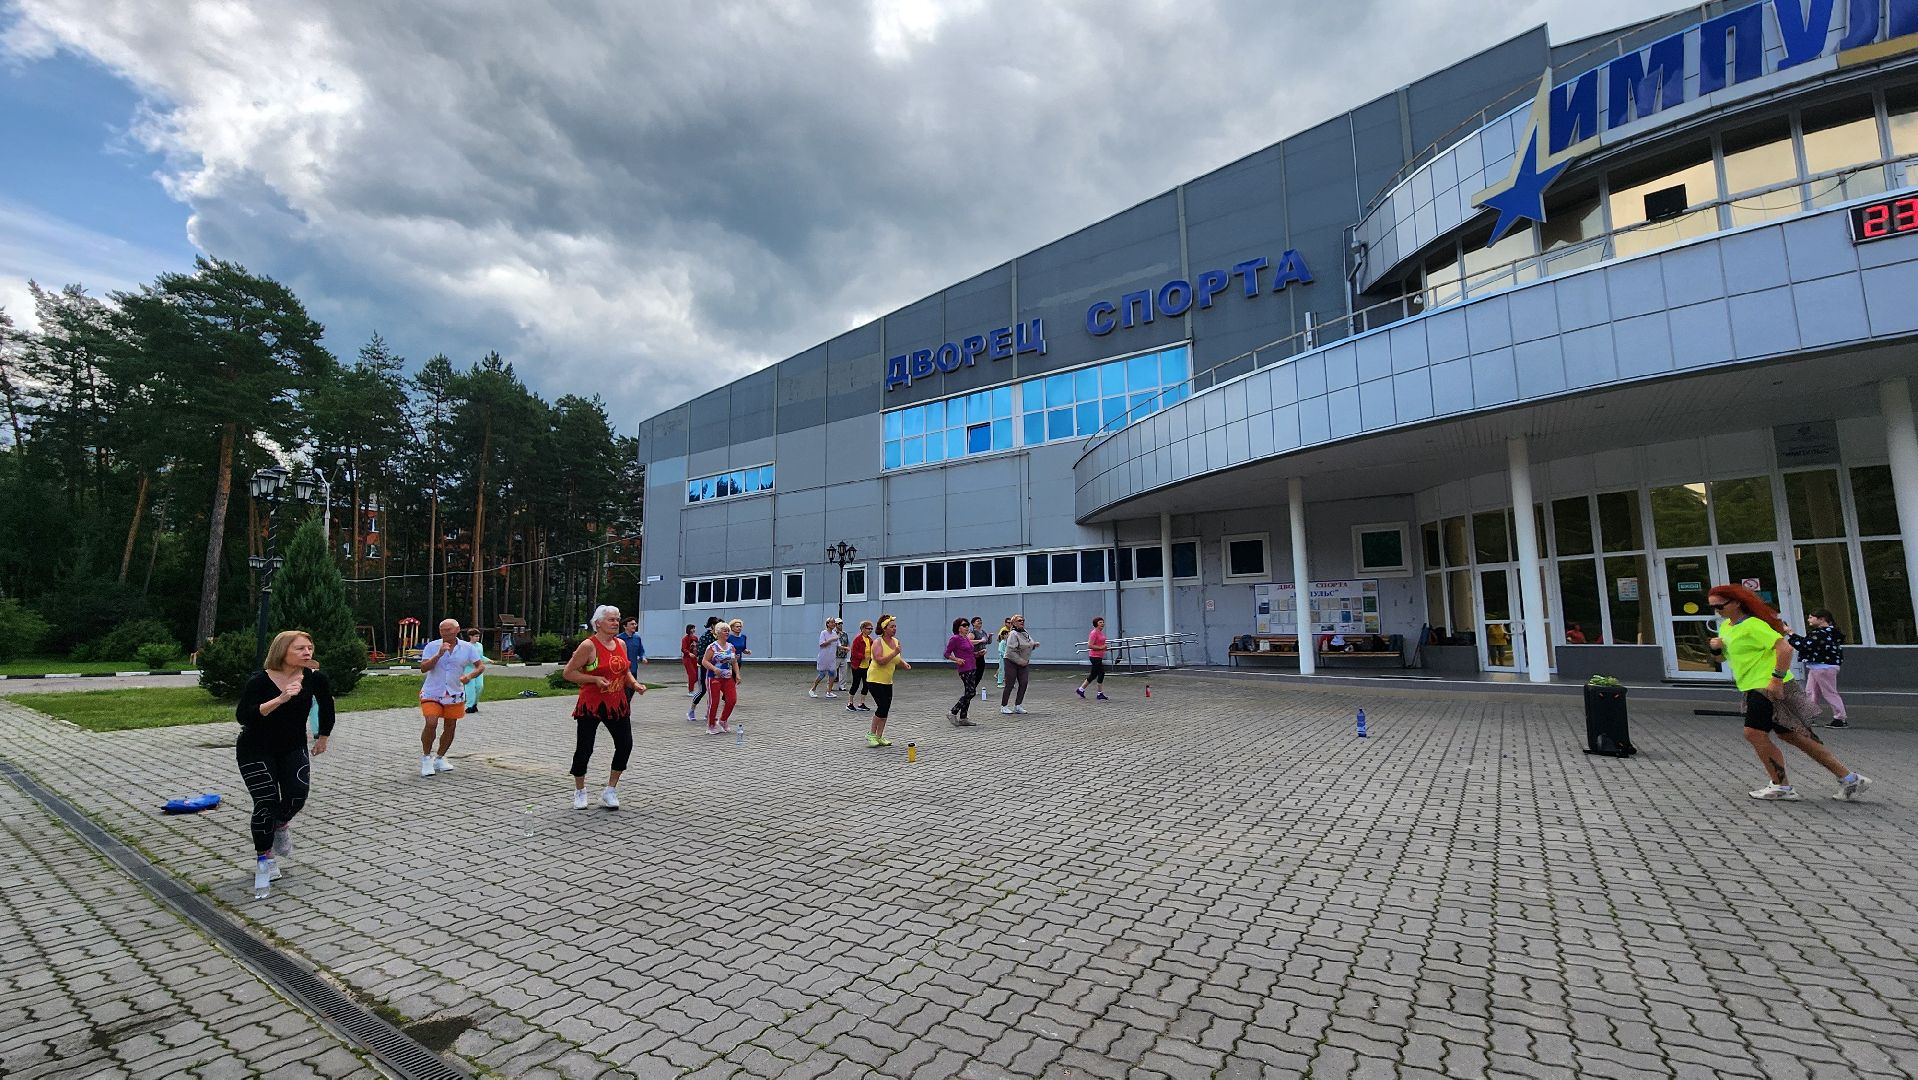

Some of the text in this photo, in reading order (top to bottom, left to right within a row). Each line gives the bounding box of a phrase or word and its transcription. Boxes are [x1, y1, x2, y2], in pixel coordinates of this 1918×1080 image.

[1864, 198, 1918, 238] 23
[885, 249, 1314, 391] ДВОРЕЦ СПОРТА
